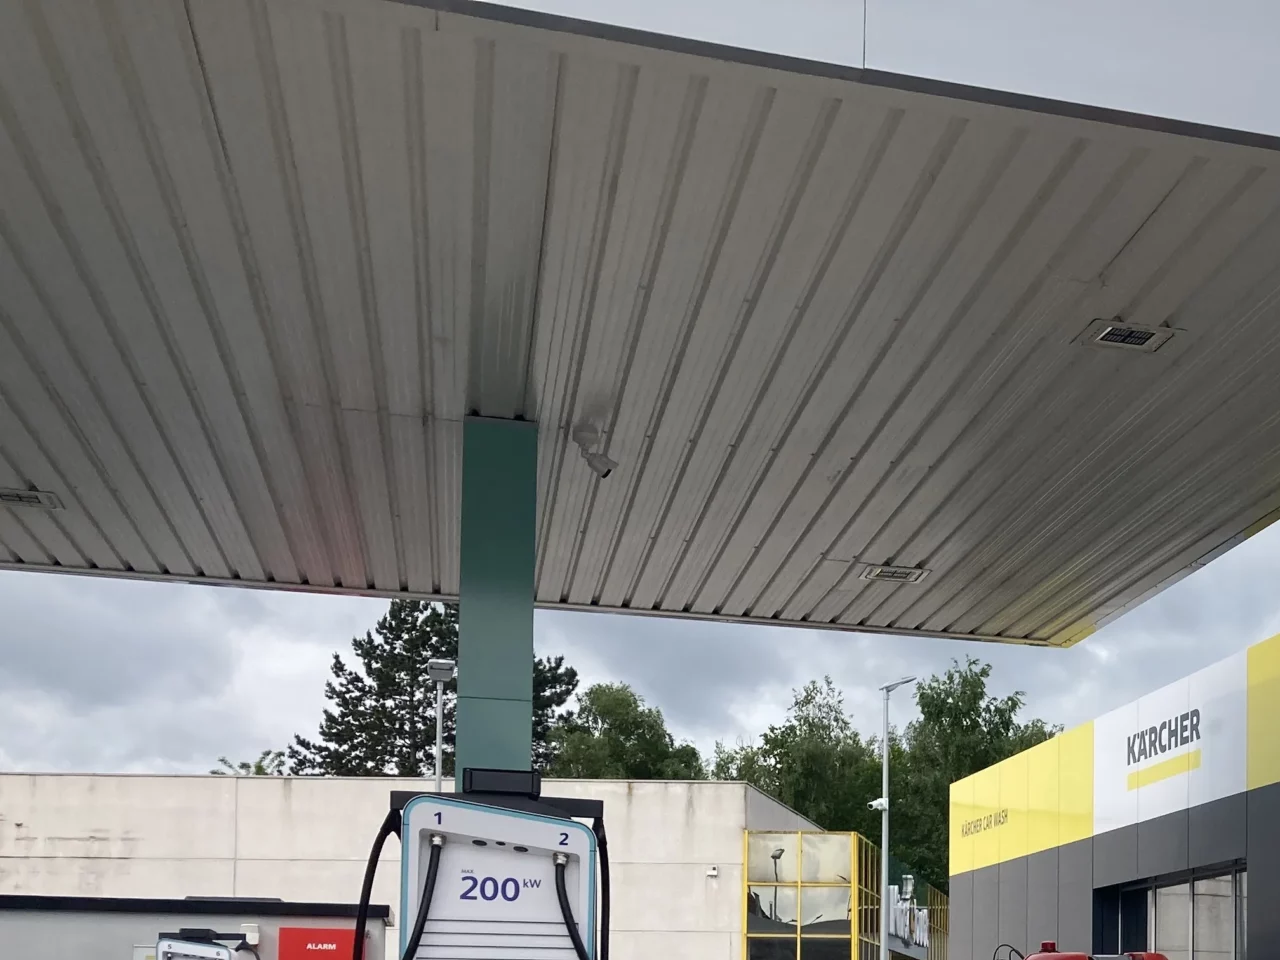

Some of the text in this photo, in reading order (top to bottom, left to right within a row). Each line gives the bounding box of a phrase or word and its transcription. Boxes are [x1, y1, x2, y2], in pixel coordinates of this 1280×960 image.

[1127, 708, 1201, 766] KÄRCHER
[434, 812, 442, 825] 1
[961, 808, 1008, 838] KÄRCHER CAR WASH
[558, 833, 569, 846] 2
[459, 876, 542, 902] 200 kW
